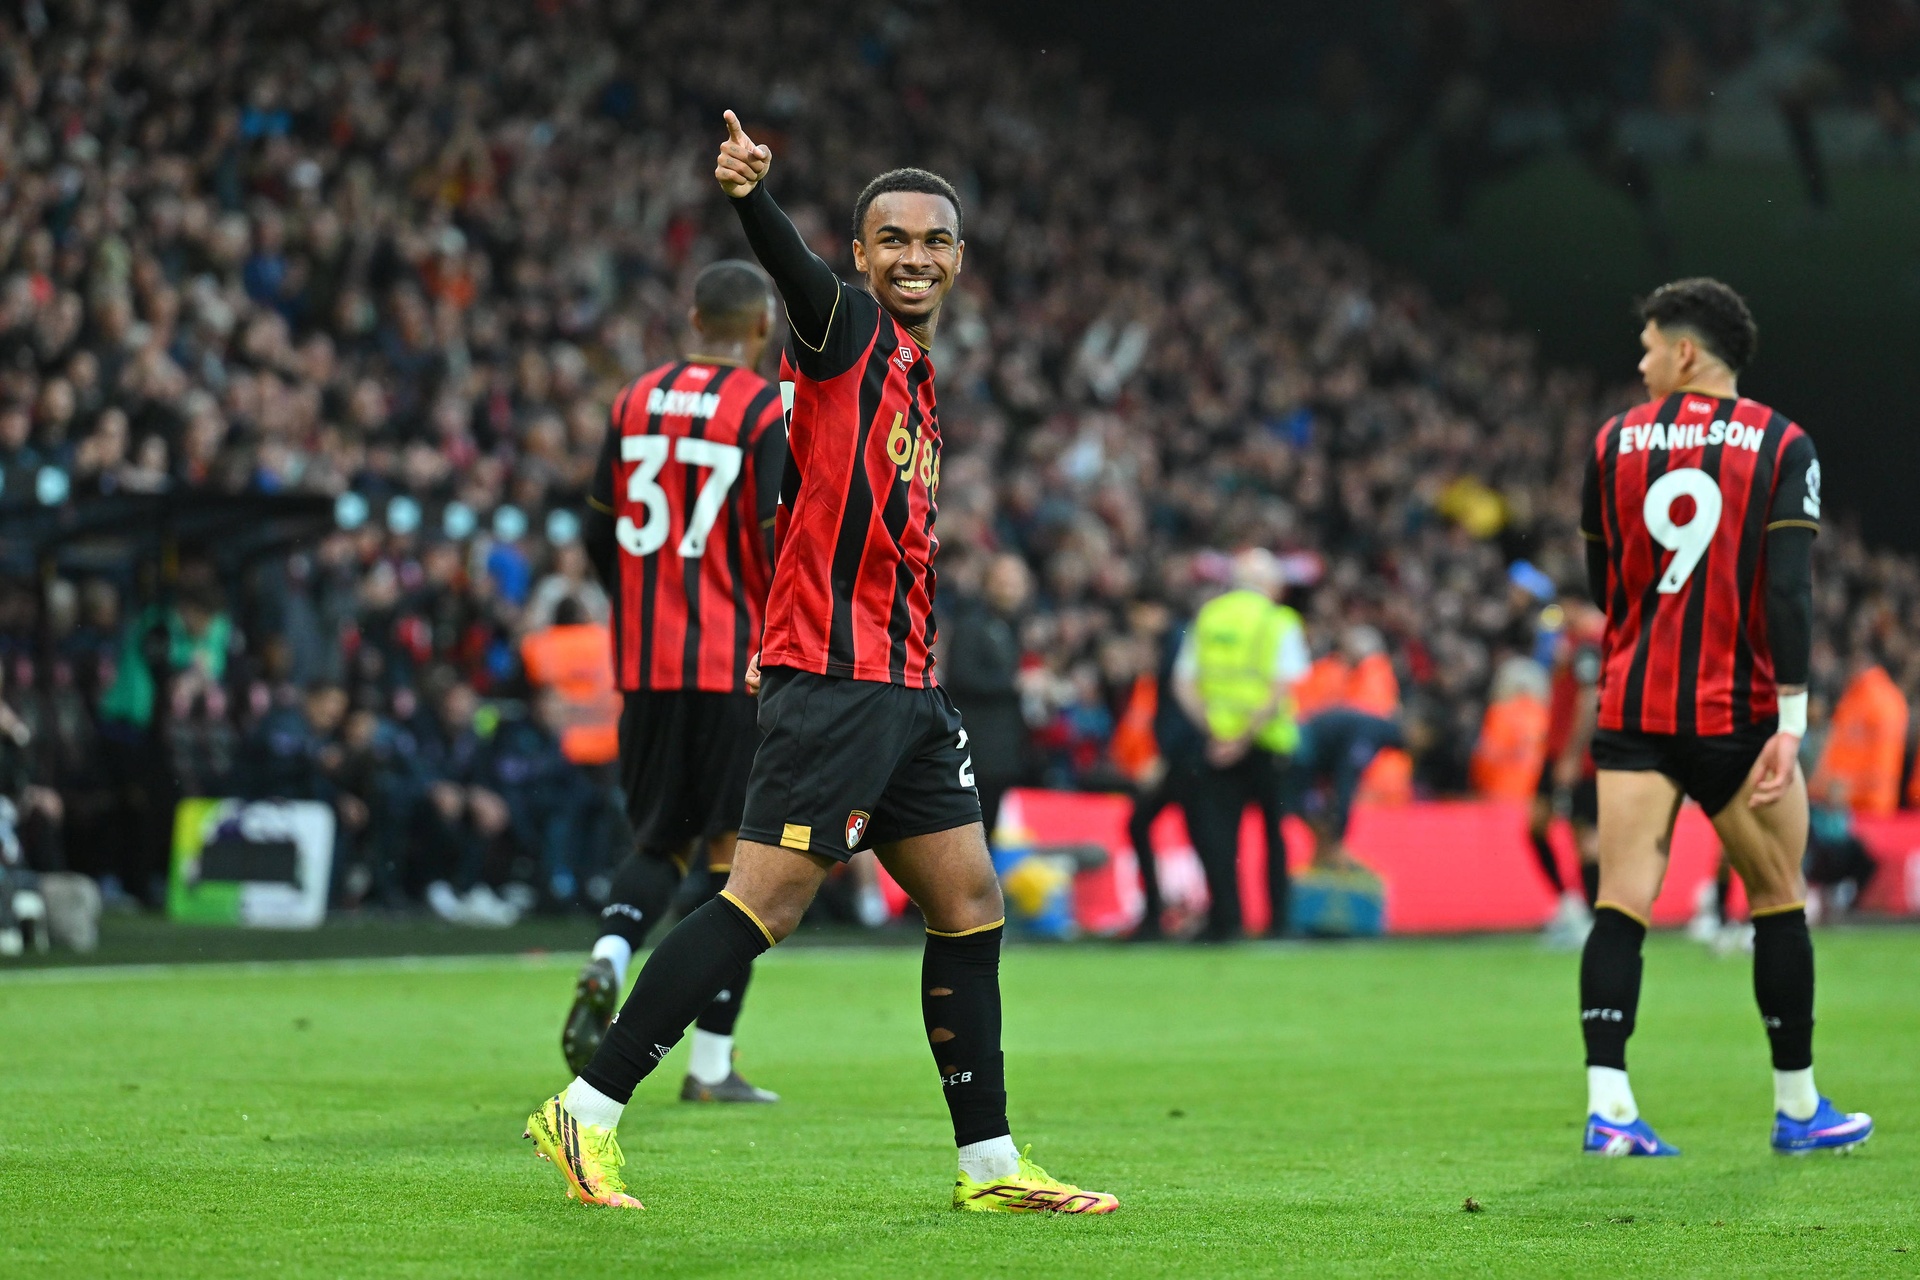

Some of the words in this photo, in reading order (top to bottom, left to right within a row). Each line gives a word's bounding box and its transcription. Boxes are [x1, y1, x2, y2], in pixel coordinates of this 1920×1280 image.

[646, 387, 721, 419] RAYAN
[886, 411, 941, 502] bj88
[1618, 419, 1765, 454] EVANILSON
[615, 434, 744, 558] 37
[1643, 467, 1723, 594] 9
[969, 1185, 1101, 1214] F50
